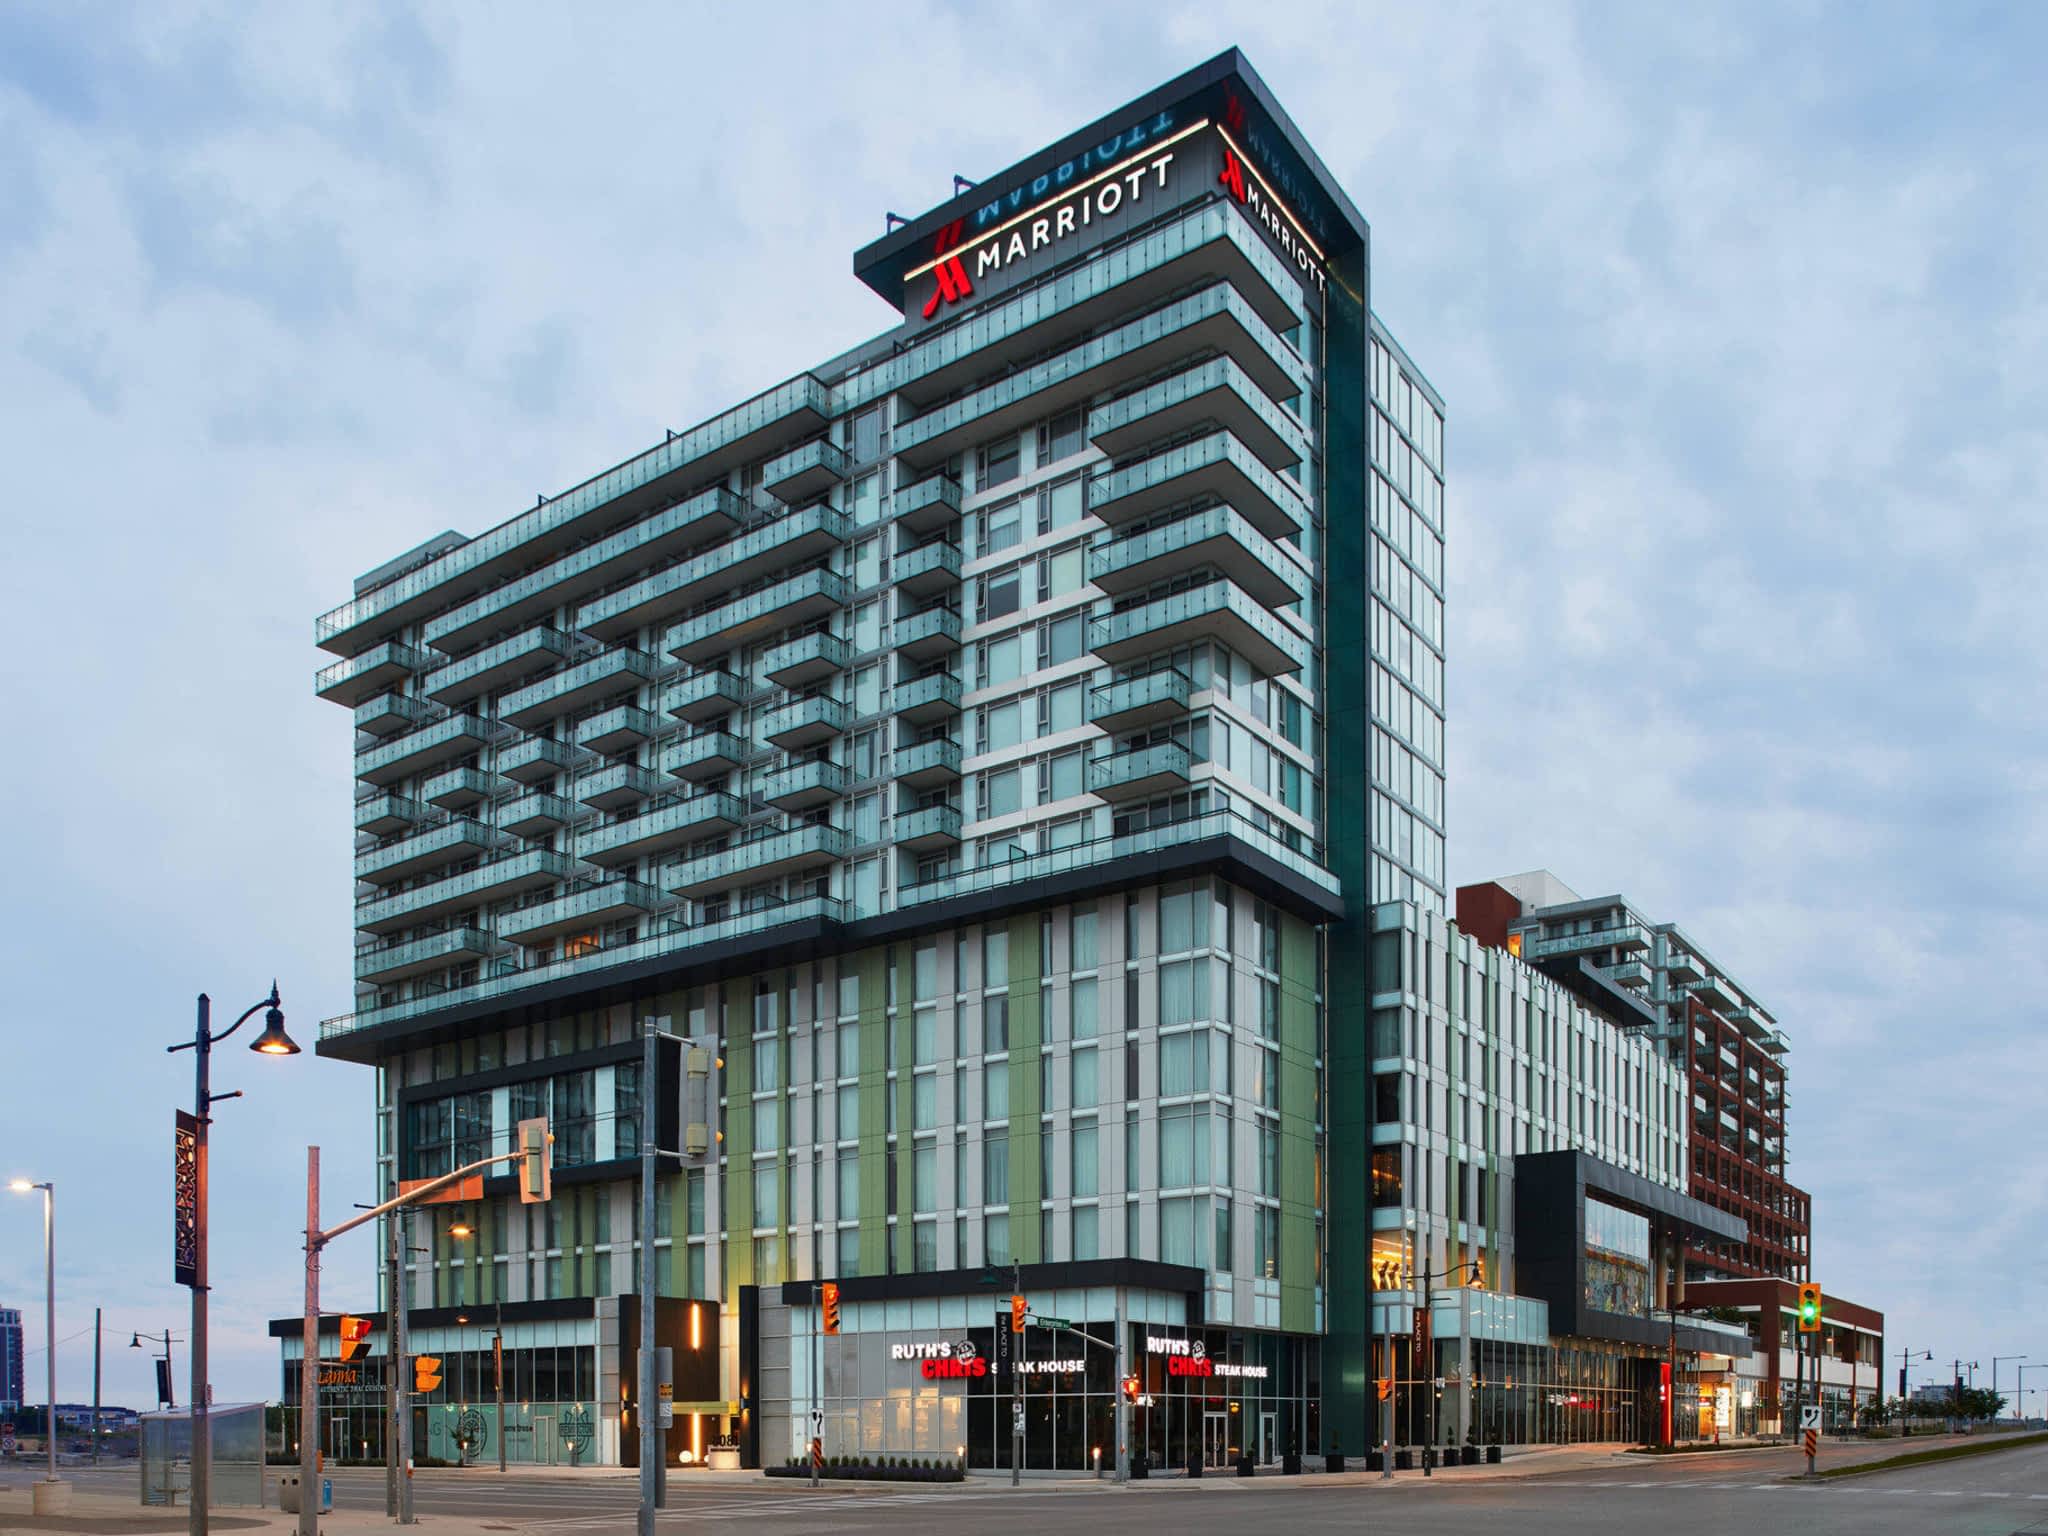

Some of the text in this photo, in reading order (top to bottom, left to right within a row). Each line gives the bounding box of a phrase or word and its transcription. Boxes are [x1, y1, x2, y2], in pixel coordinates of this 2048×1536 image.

[977, 153, 1174, 278] MARRIOTT
[1247, 183, 1326, 292] MARRIOTT
[892, 1342, 951, 1360] RUTH'S
[1001, 1346, 1008, 1357] TO
[1147, 1337, 1190, 1356] RUTH'S
[921, 1357, 986, 1379] CHRIS
[1037, 1360, 1085, 1373] HOUSE
[1168, 1356, 1268, 1378] CHRIS STEAK HOUSE
